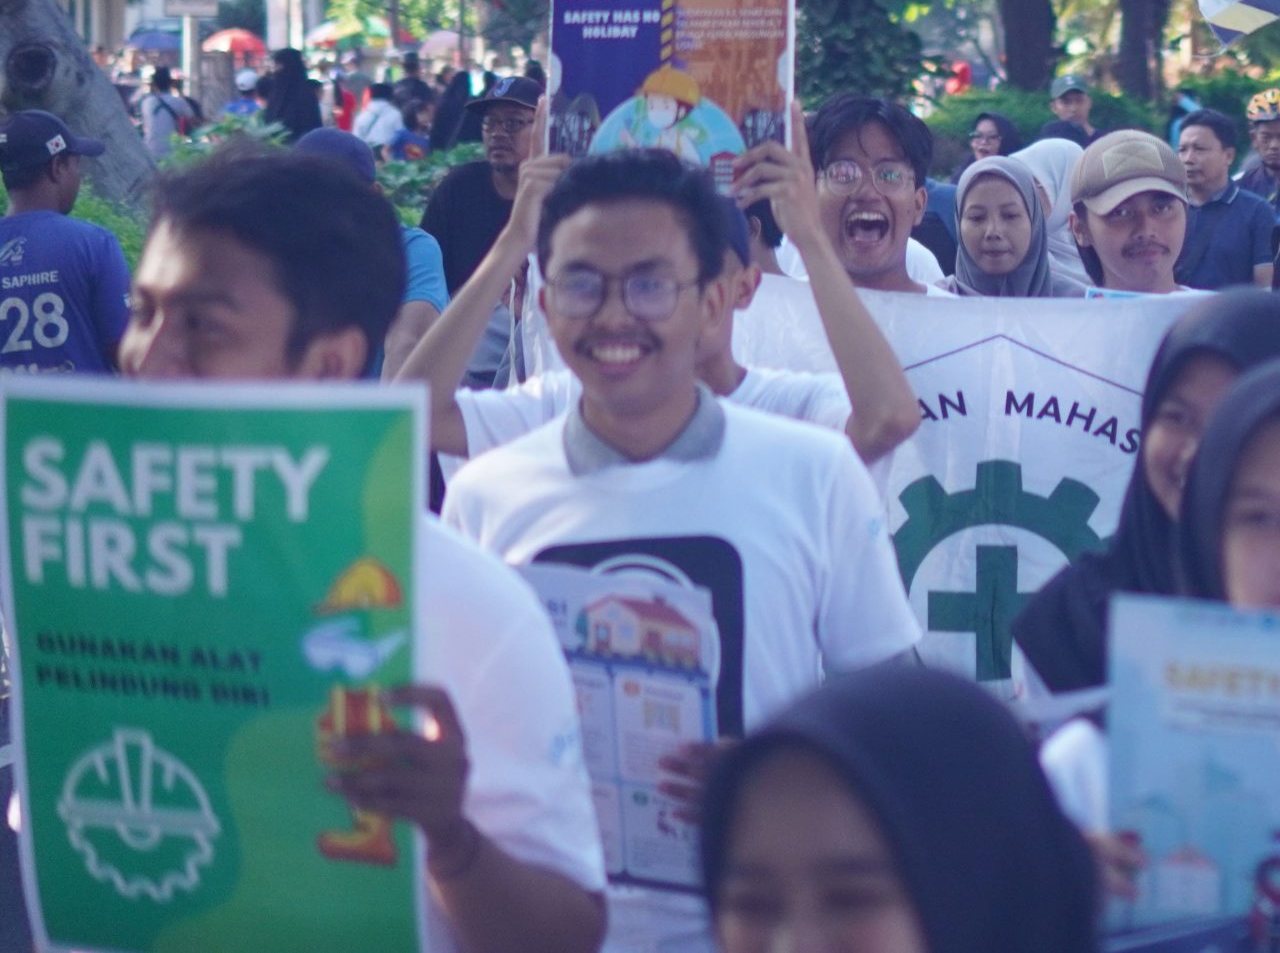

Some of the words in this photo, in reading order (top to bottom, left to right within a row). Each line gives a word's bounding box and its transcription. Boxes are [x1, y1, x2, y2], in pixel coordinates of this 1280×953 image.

[563, 10, 610, 25] SAFETY
[612, 9, 641, 24] HAS
[642, 9, 661, 24] NO
[582, 24, 639, 39] HOLIDAY
[1, 269, 60, 290] SAPHIRE
[0, 291, 69, 354] 28
[1004, 389, 1143, 455] MAHAS
[21, 436, 331, 524] SAFETY
[21, 512, 243, 599] FIRST
[36, 631, 181, 665] GUNAKAN
[189, 644, 264, 674] ALAT
[36, 663, 203, 702] PELINDUNG
[209, 682, 271, 708] DIRI
